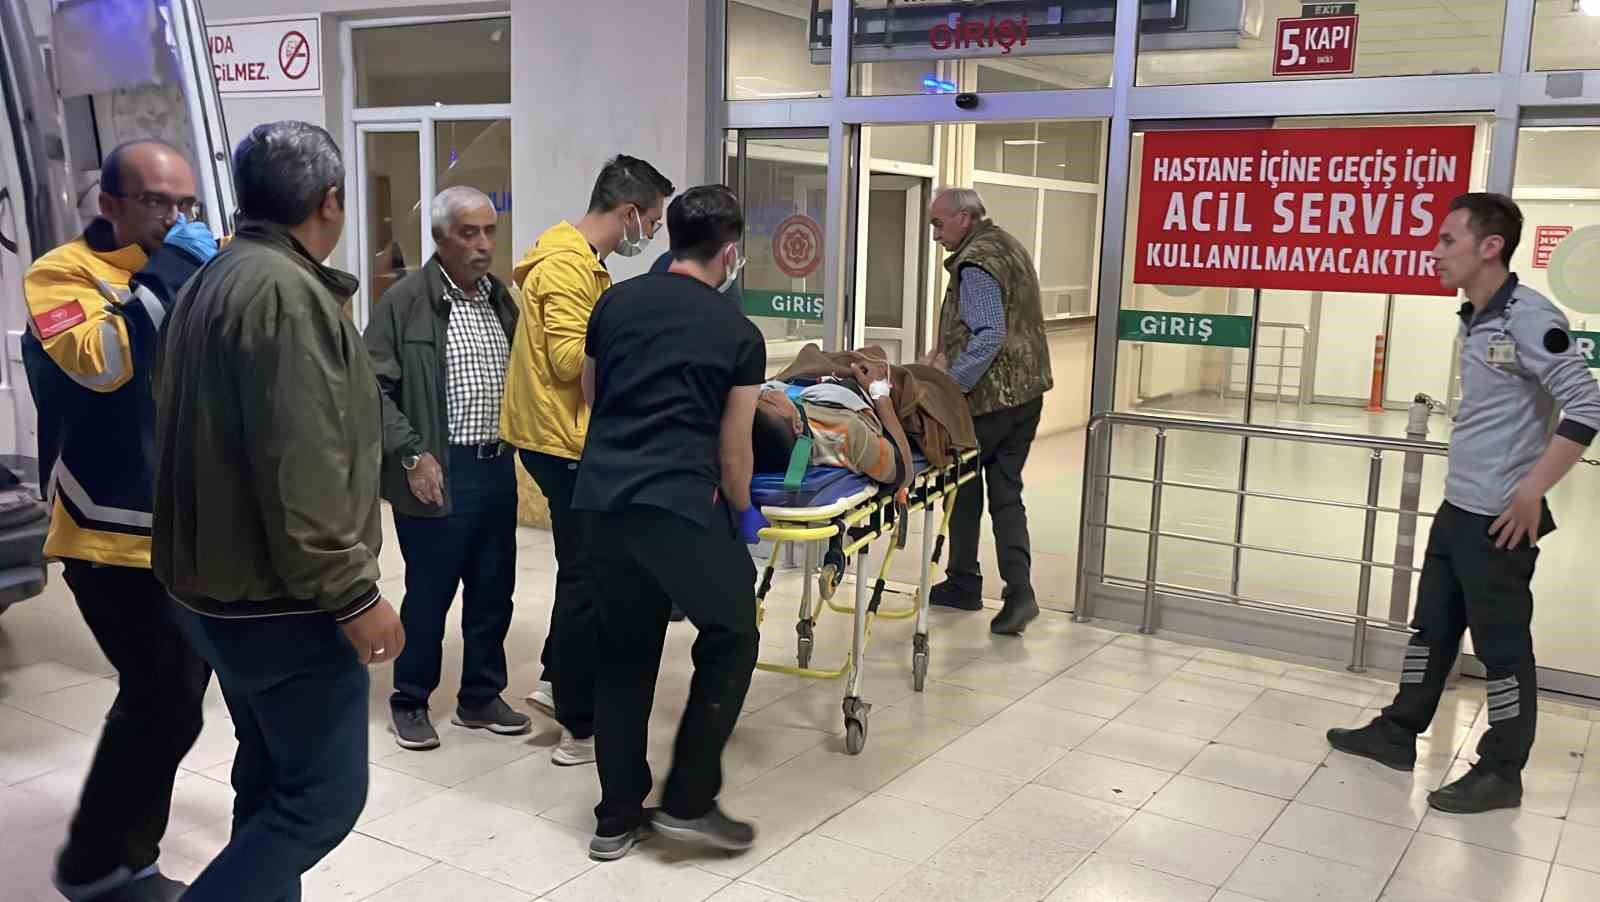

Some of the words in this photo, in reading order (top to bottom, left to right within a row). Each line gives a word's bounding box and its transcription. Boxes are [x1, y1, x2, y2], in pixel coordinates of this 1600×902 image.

[1314, 5, 1342, 15] EXIT
[1280, 28, 1306, 66] 5.
[1305, 26, 1350, 50] KAPI
[1153, 156, 1254, 182] HASTANE
[1259, 149, 1322, 189] İÇİNE
[1327, 148, 1397, 189] GEÇİŞ
[1403, 148, 1457, 190] İÇİN
[1162, 191, 1252, 232] ACİL
[1272, 192, 1434, 237] SERVİS
[772, 295, 824, 318] GİRİŞ
[1140, 315, 1213, 342] GİRİŞ
